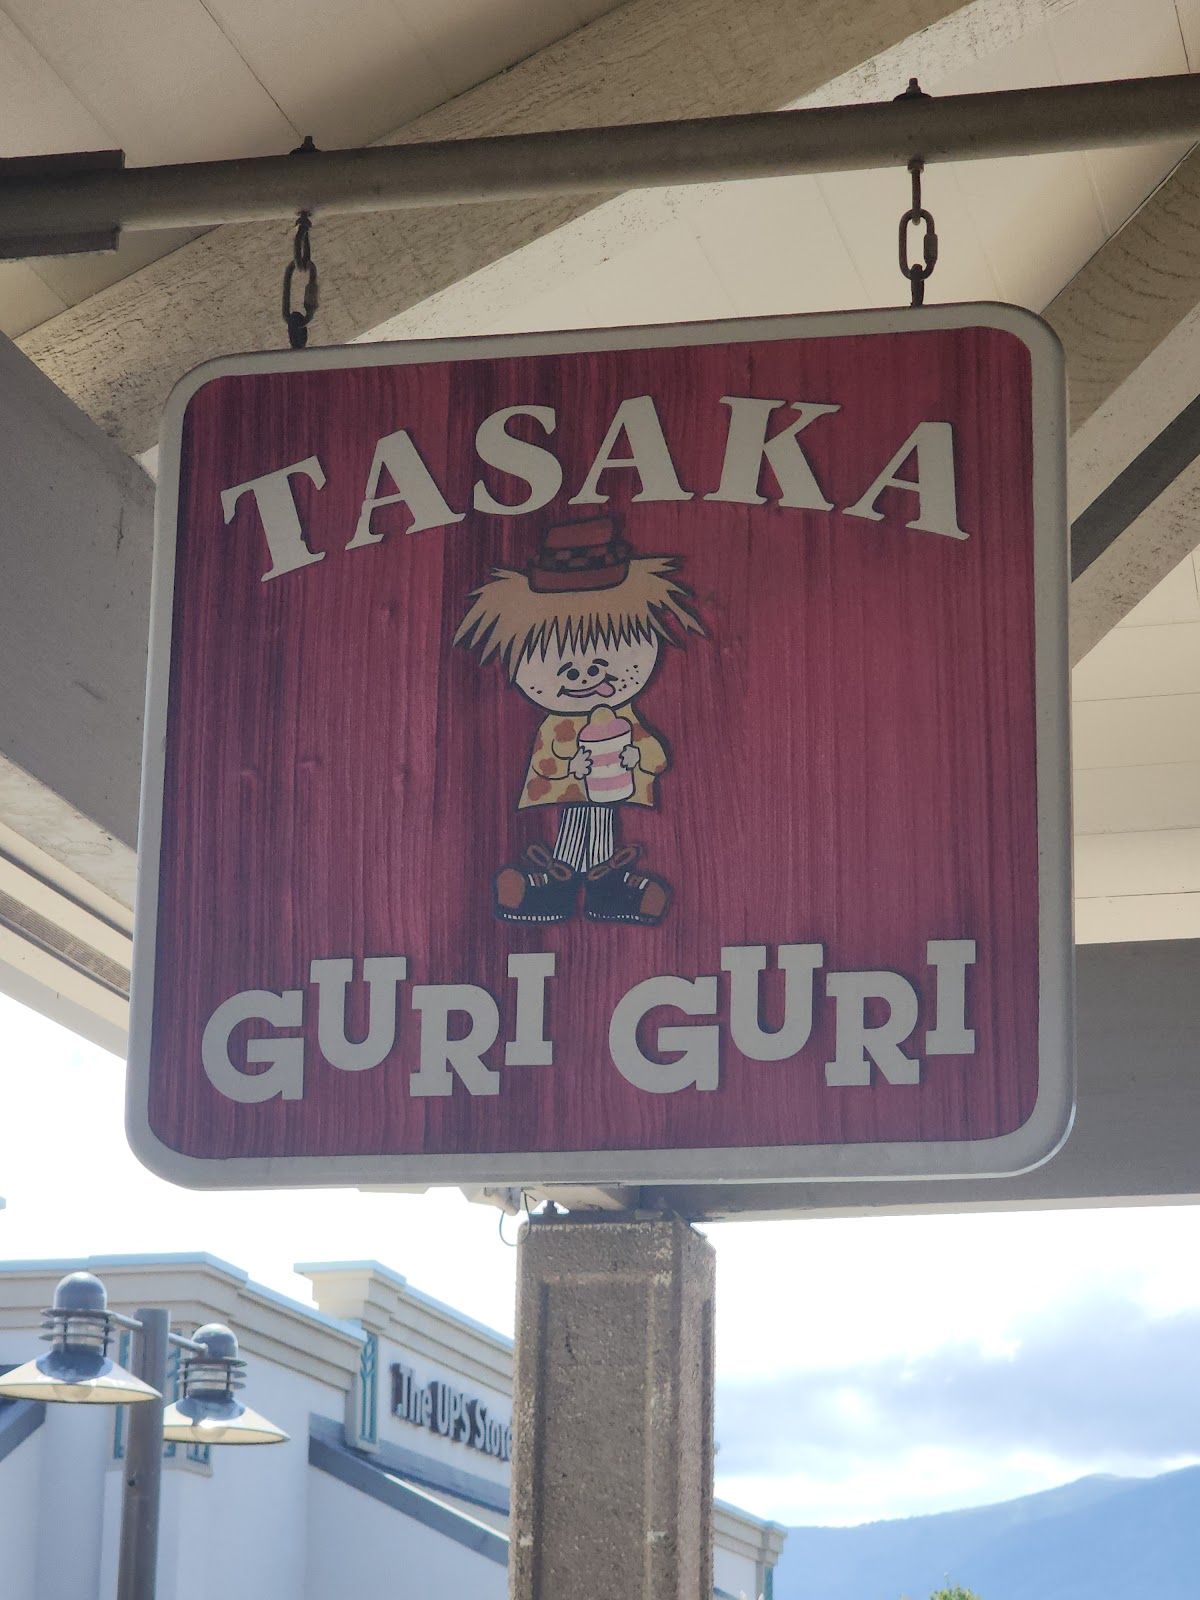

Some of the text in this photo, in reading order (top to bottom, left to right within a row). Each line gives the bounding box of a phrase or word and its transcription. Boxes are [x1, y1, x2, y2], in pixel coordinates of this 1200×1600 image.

[220, 395, 970, 582] TASAKA
[201, 939, 976, 1104] GURI GURI
[394, 1364, 432, 1427] The
[437, 1381, 471, 1444] UPS
